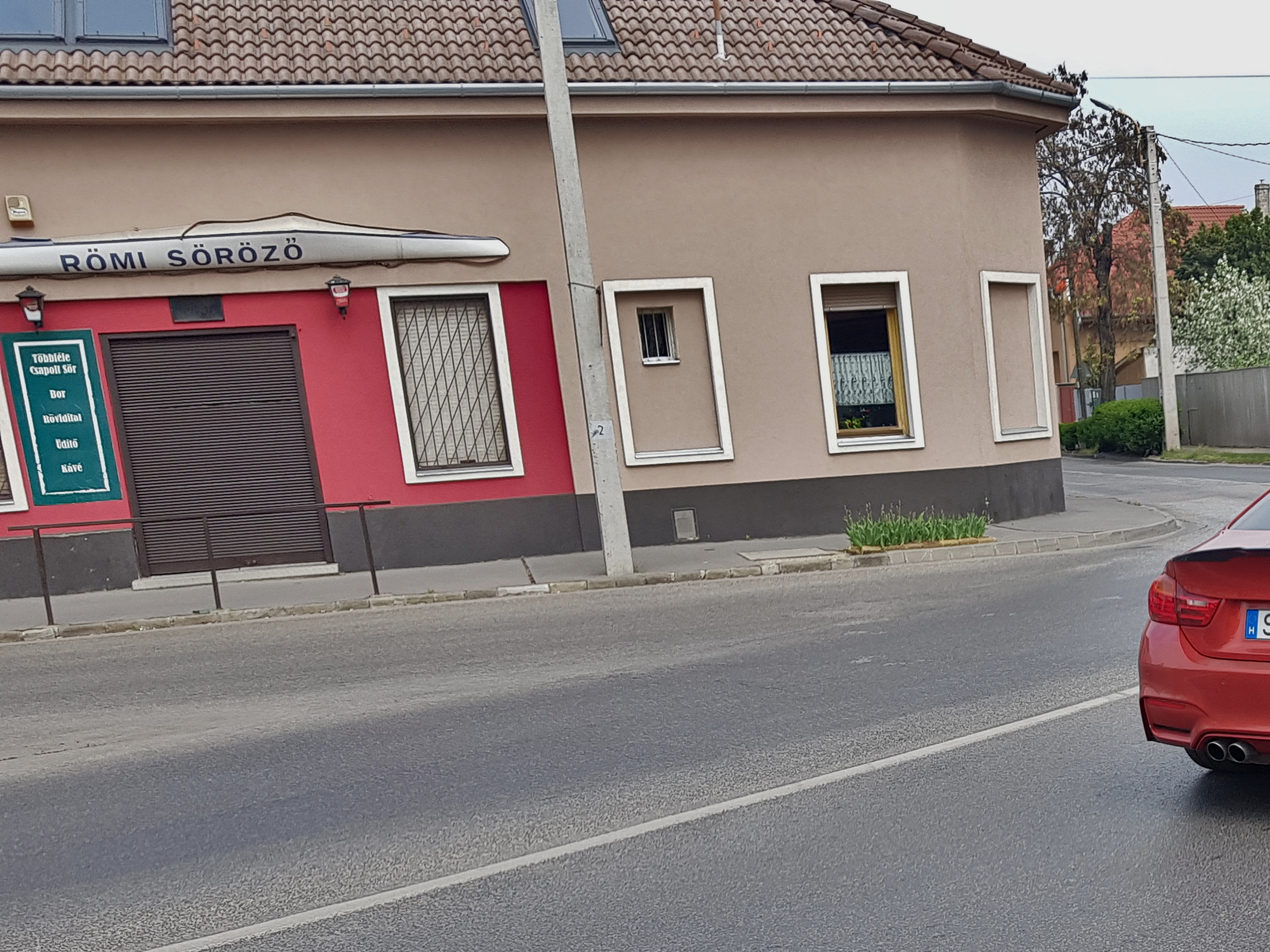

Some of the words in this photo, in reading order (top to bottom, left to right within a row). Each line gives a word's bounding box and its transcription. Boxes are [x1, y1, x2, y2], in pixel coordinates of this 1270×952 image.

[59, 248, 148, 272] RÖMI
[167, 238, 303, 268] SÖRÖZŐ
[49, 389, 66, 399] Bor
[61, 462, 83, 473] Kávé
[1248, 626, 1255, 635] H
